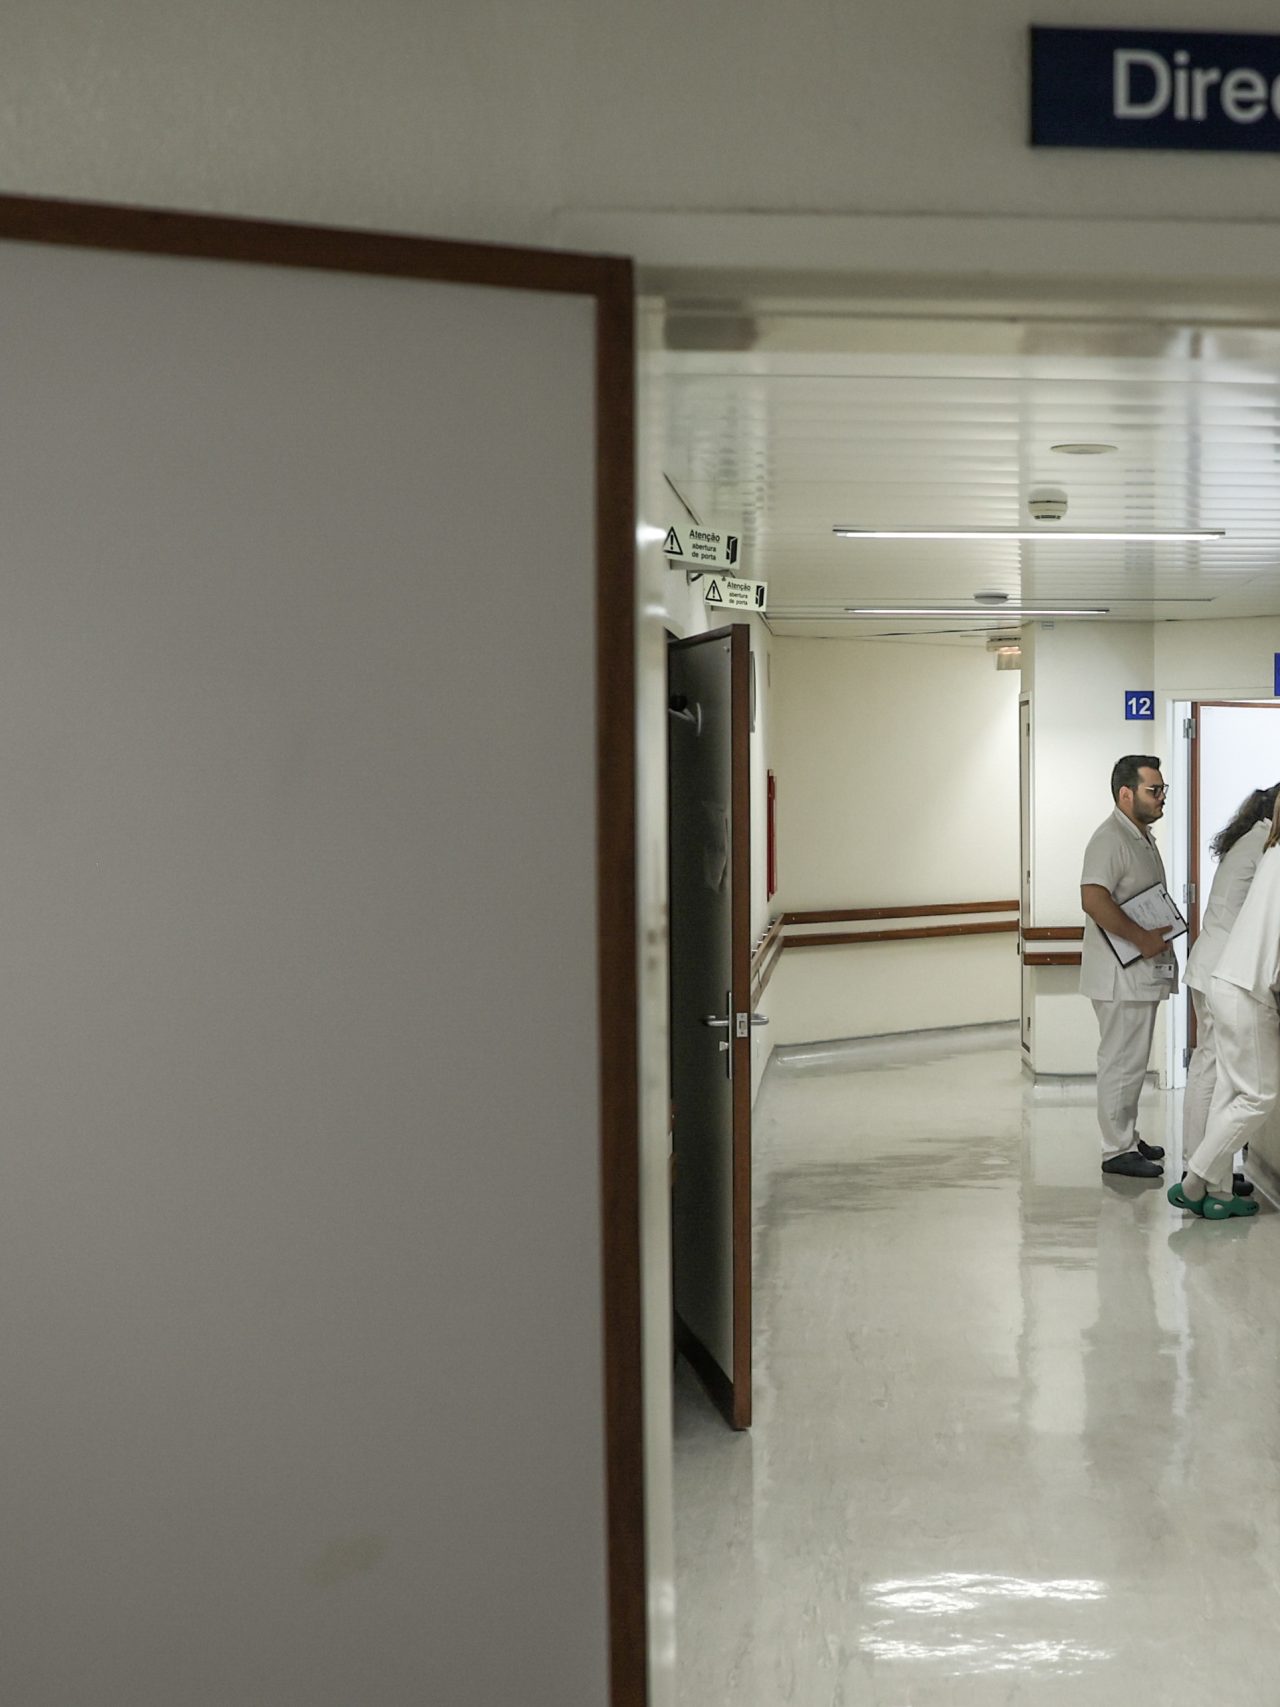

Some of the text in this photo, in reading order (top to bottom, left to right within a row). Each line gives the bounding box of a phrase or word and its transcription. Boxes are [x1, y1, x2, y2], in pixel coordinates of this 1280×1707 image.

[689, 529, 720, 542] Atenção
[692, 543, 716, 552] abertura
[727, 581, 751, 592] Atenção
[1128, 697, 1151, 715] 12
